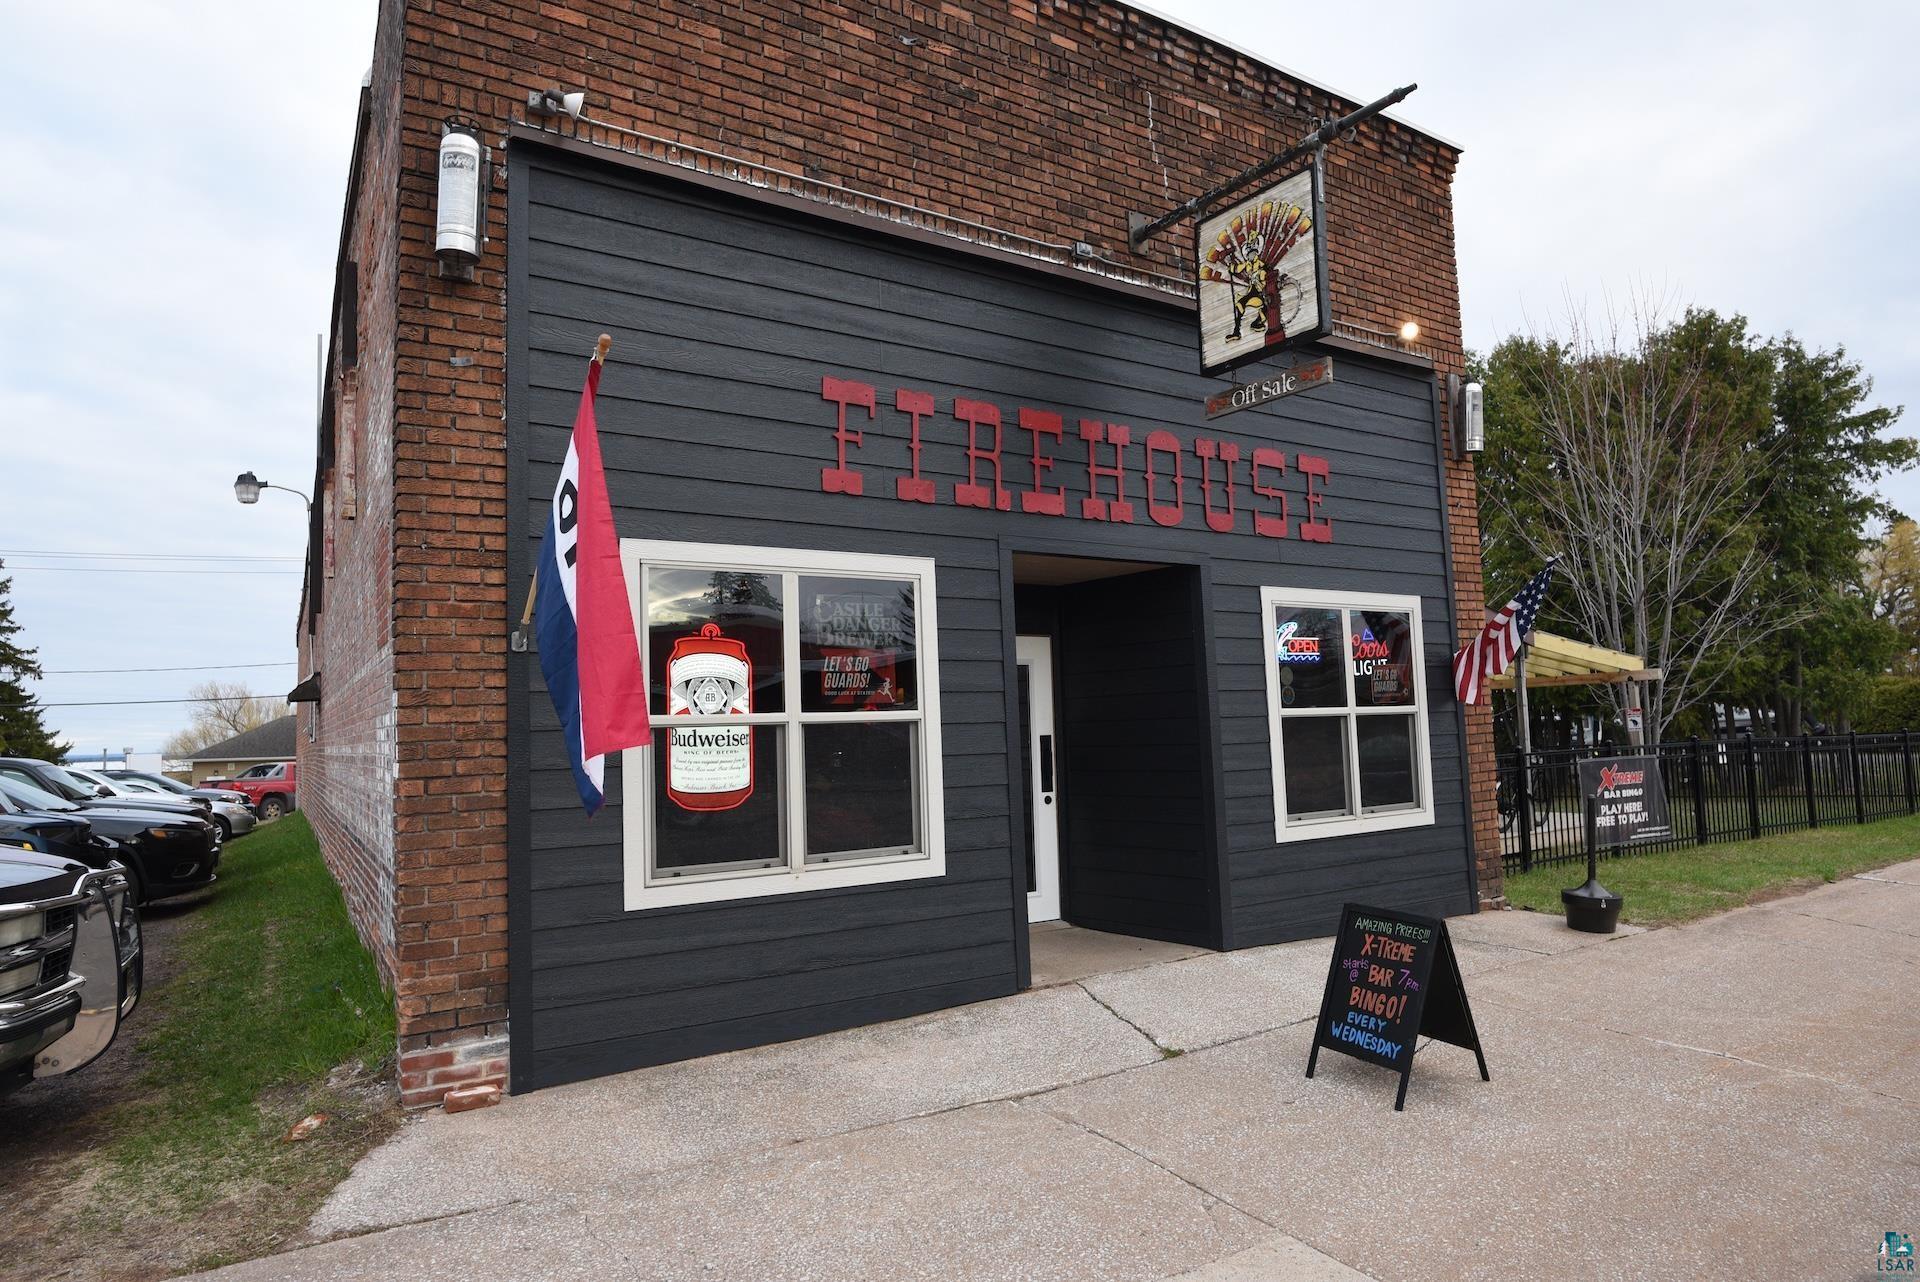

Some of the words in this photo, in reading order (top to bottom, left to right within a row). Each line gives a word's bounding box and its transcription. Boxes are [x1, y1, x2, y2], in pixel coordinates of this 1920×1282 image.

[1231, 382, 1258, 408] Off
[1261, 373, 1297, 400] Sale
[820, 375, 1333, 544] FIREHOUSE
[814, 600, 885, 622] CASTLE
[832, 616, 900, 632] DANGER
[1289, 640, 1319, 653] OPEN
[1352, 634, 1389, 659] Coors
[823, 656, 854, 672] LET'S
[854, 656, 870, 672] GO
[823, 672, 871, 689] GUARDS!
[671, 728, 749, 748] Budweiser
[1604, 789, 1621, 799] BAR
[1622, 788, 1643, 798] BINGO
[1601, 804, 1622, 815] PLAY
[1623, 801, 1643, 813] HERE!
[1596, 815, 1616, 827] FREE
[1618, 815, 1628, 824] TO
[1629, 811, 1649, 823] PLAY!
[1354, 917, 1393, 935] AMAZING
[1360, 933, 1417, 963] X-TREME
[1342, 959, 1369, 970] starts
[1349, 969, 1360, 982] @
[1367, 964, 1395, 987] BAR
[1398, 968, 1410, 985] 7
[1349, 985, 1408, 1024] BINGO!
[1347, 1011, 1388, 1032] EVERY
[1331, 1021, 1402, 1060] WEDNESDAY
